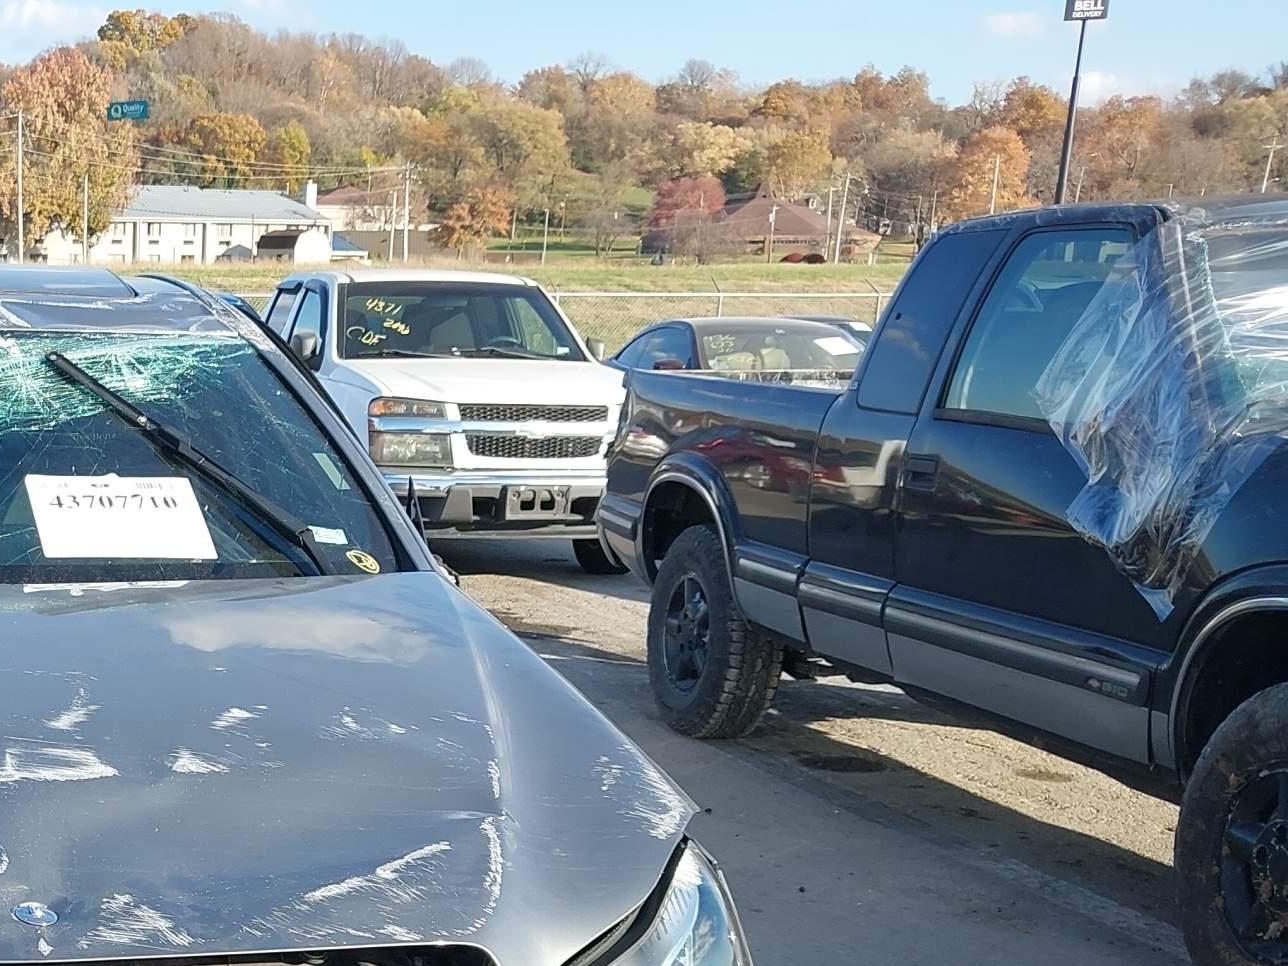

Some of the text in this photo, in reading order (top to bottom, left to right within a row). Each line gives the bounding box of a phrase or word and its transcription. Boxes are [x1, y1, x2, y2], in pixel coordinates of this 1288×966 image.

[1074, 0, 1104, 11] BELL
[365, 298, 402, 316] 4371
[49, 494, 178, 509] 43707710
